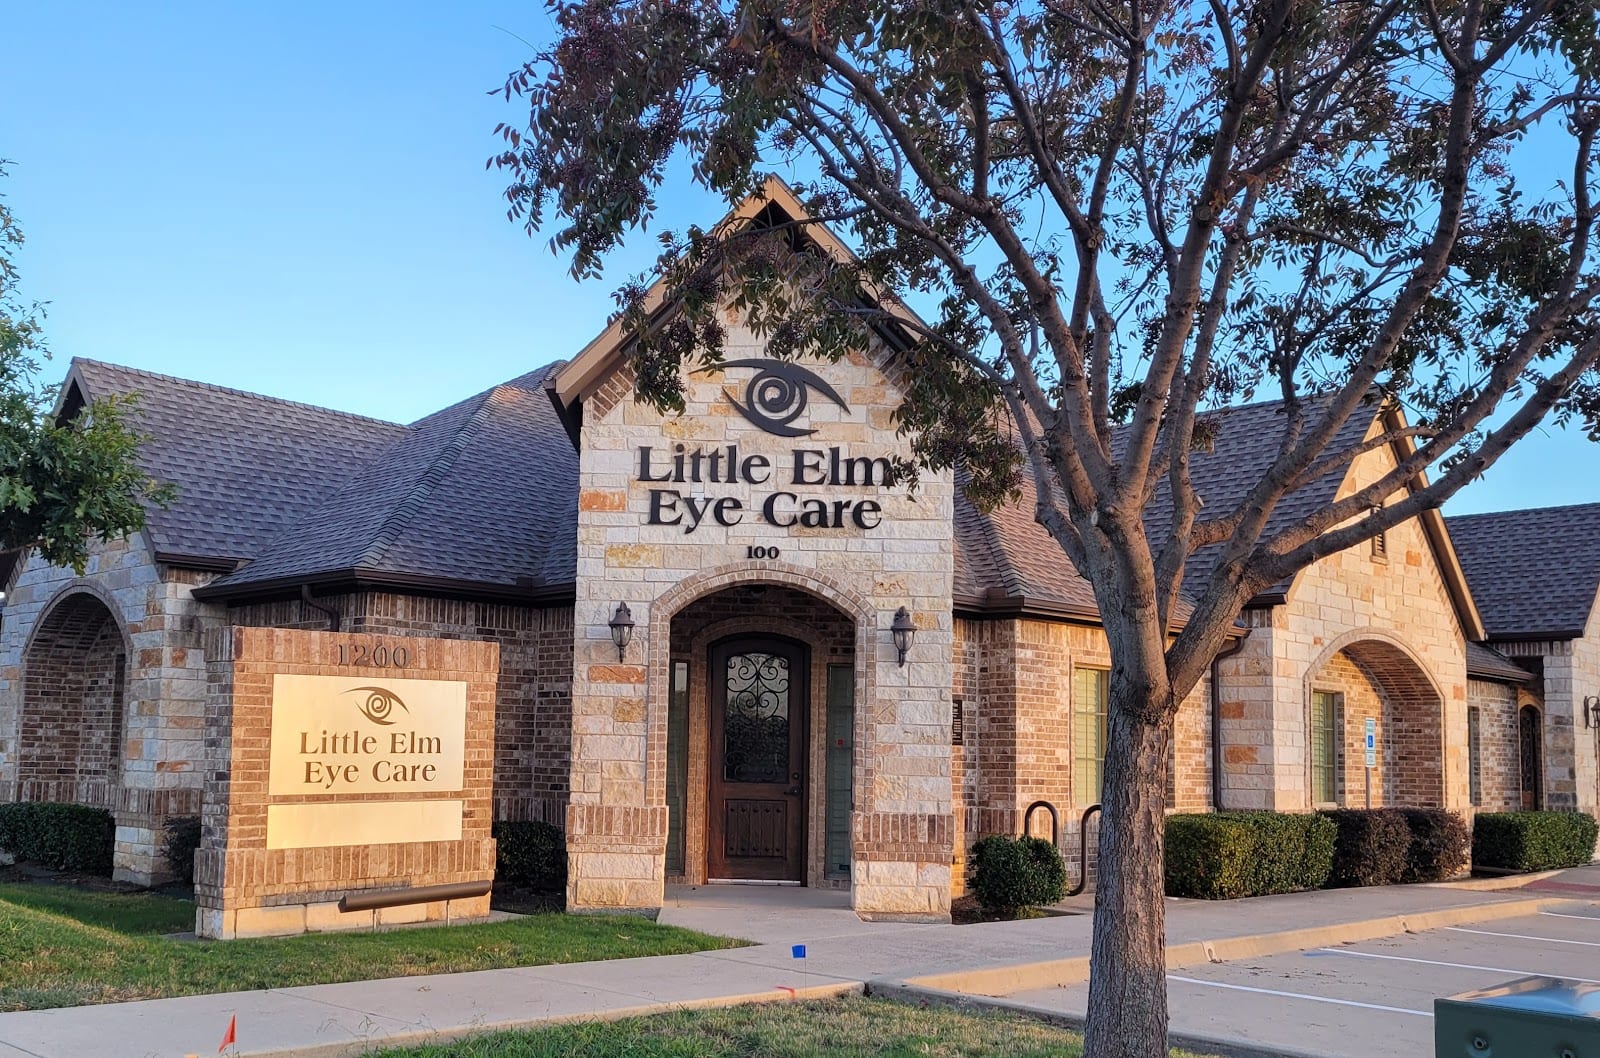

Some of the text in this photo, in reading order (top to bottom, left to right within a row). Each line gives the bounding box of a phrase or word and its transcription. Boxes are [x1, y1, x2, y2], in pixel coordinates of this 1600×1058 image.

[637, 444, 895, 487] Little Elm
[647, 489, 882, 534] Eye Care
[747, 546, 779, 559] 100
[337, 644, 411, 669] 1200
[299, 730, 442, 755] Little Elm
[304, 760, 436, 789] Eye Care
